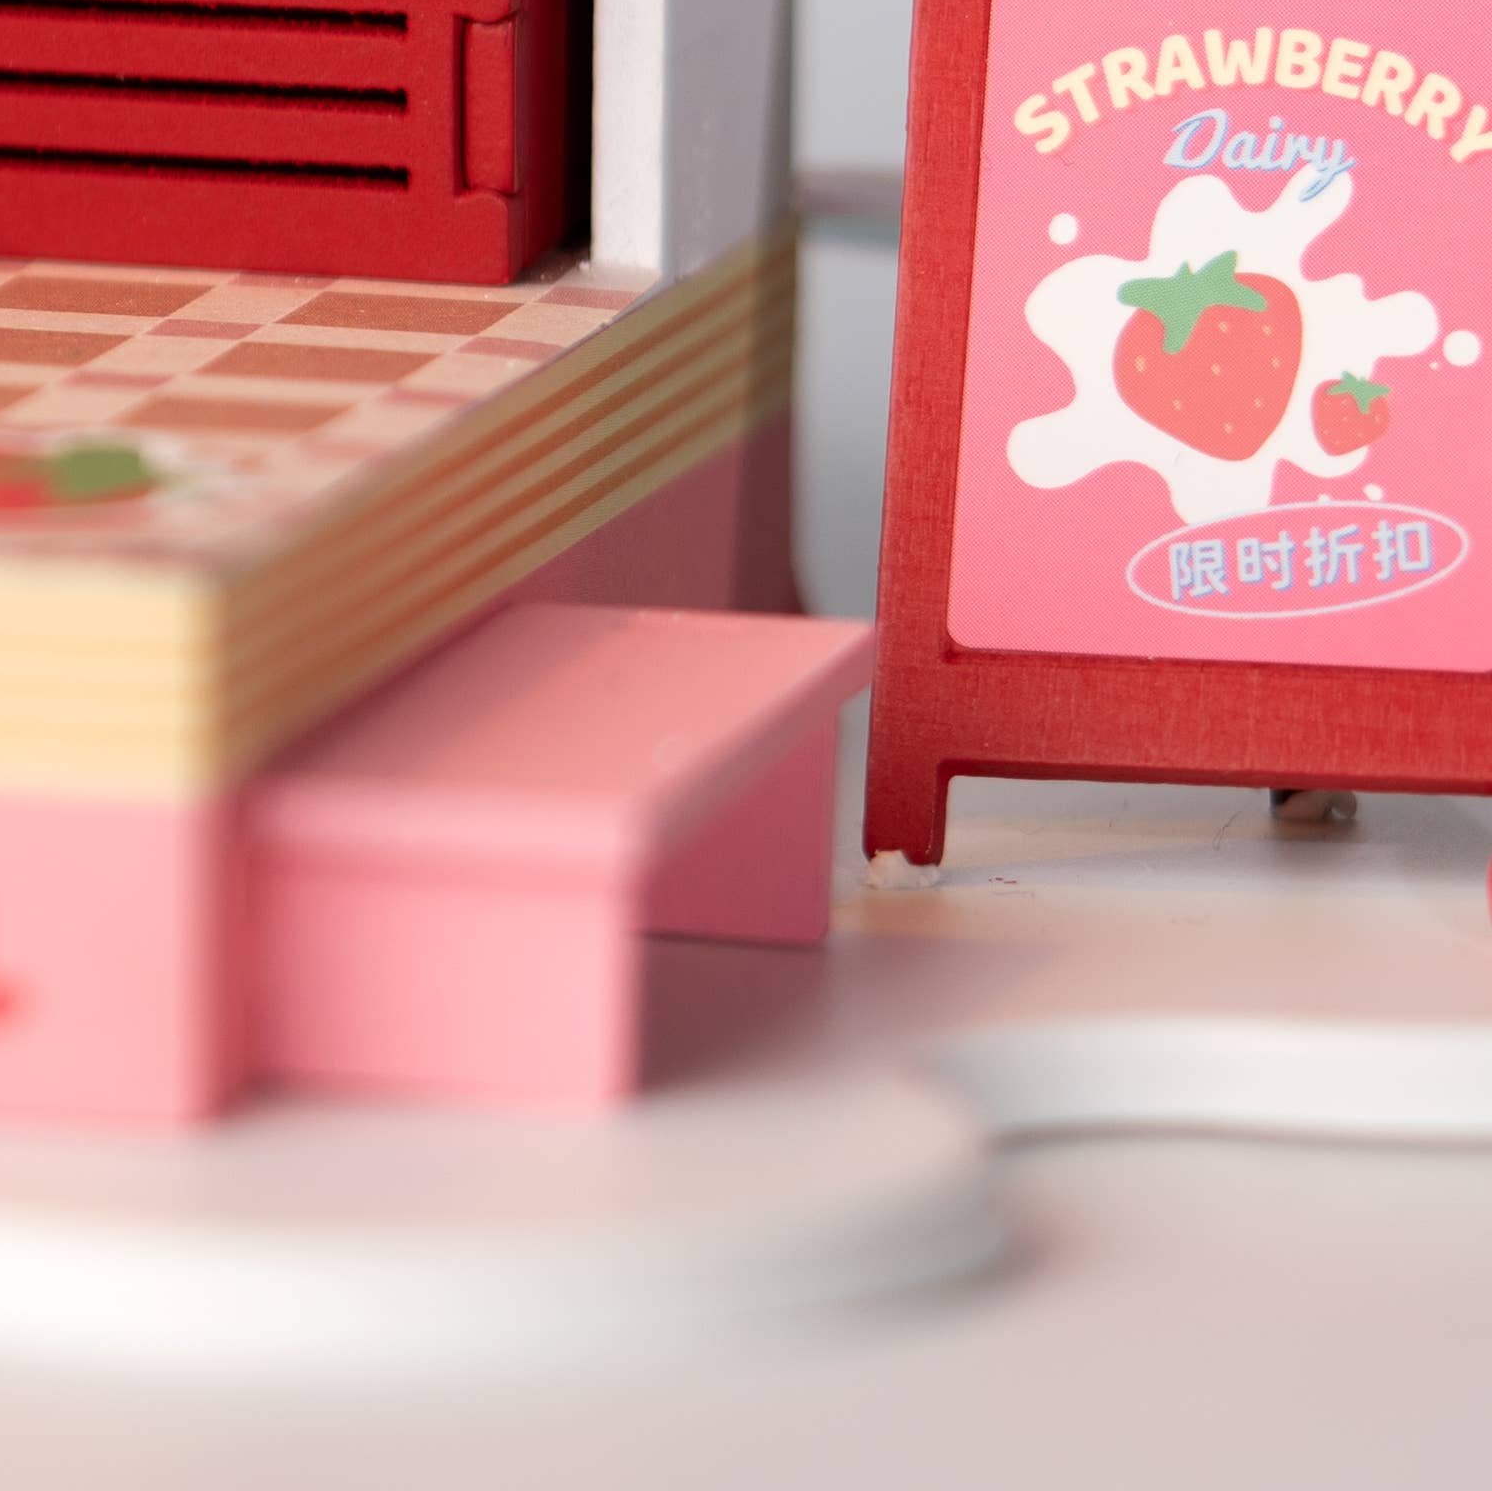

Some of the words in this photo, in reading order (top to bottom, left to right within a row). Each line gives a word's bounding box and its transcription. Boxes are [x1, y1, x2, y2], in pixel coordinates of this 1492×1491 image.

[1013, 26, 1492, 164] STRAWBERRY
[1163, 108, 1356, 204] Dairy
[1168, 519, 1434, 602] 限时折扣
